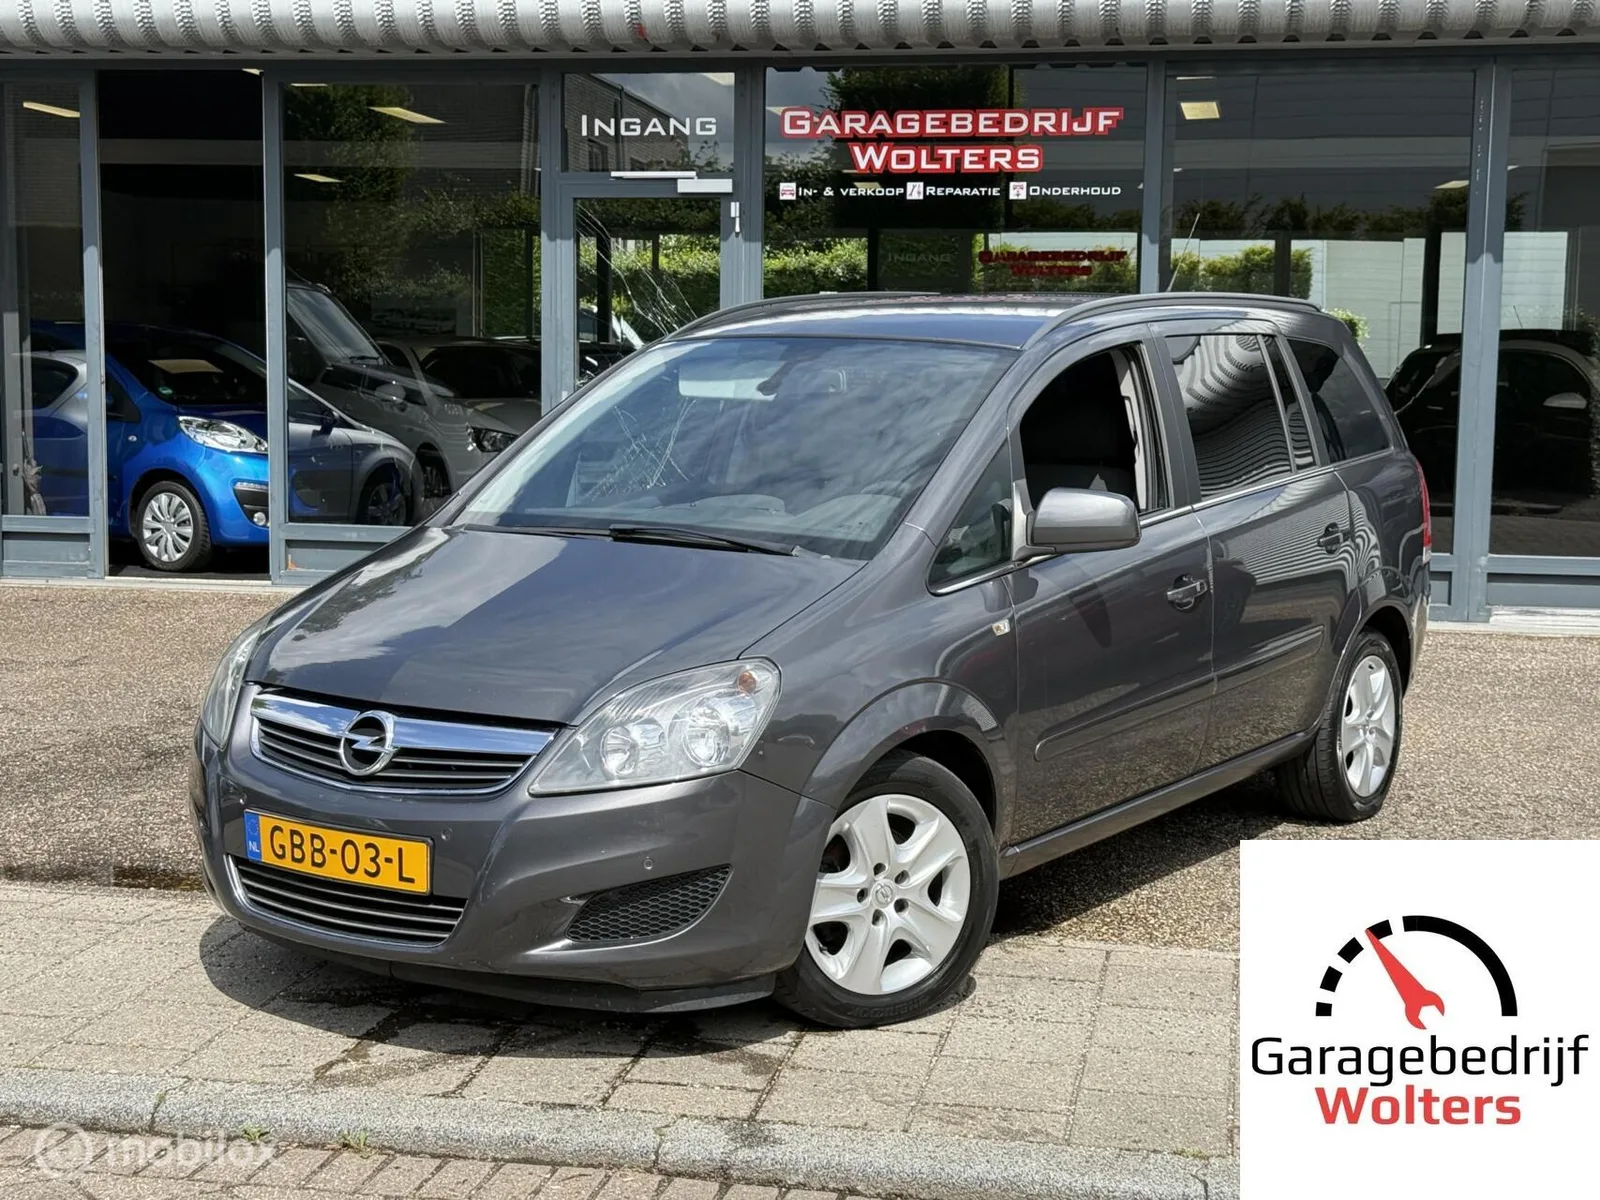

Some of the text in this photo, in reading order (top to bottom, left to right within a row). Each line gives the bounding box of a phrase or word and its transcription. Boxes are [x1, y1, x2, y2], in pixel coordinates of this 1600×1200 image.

[581, 114, 717, 137] INGANG
[782, 109, 1122, 137] GARAGEBEDRIJF
[850, 144, 1042, 172] WOLTERS
[798, 186, 1122, 197] IN- & VERKOOP REPARATIE ONDERHOUD
[248, 840, 260, 853] NL
[269, 824, 416, 884] GBB-03-L
